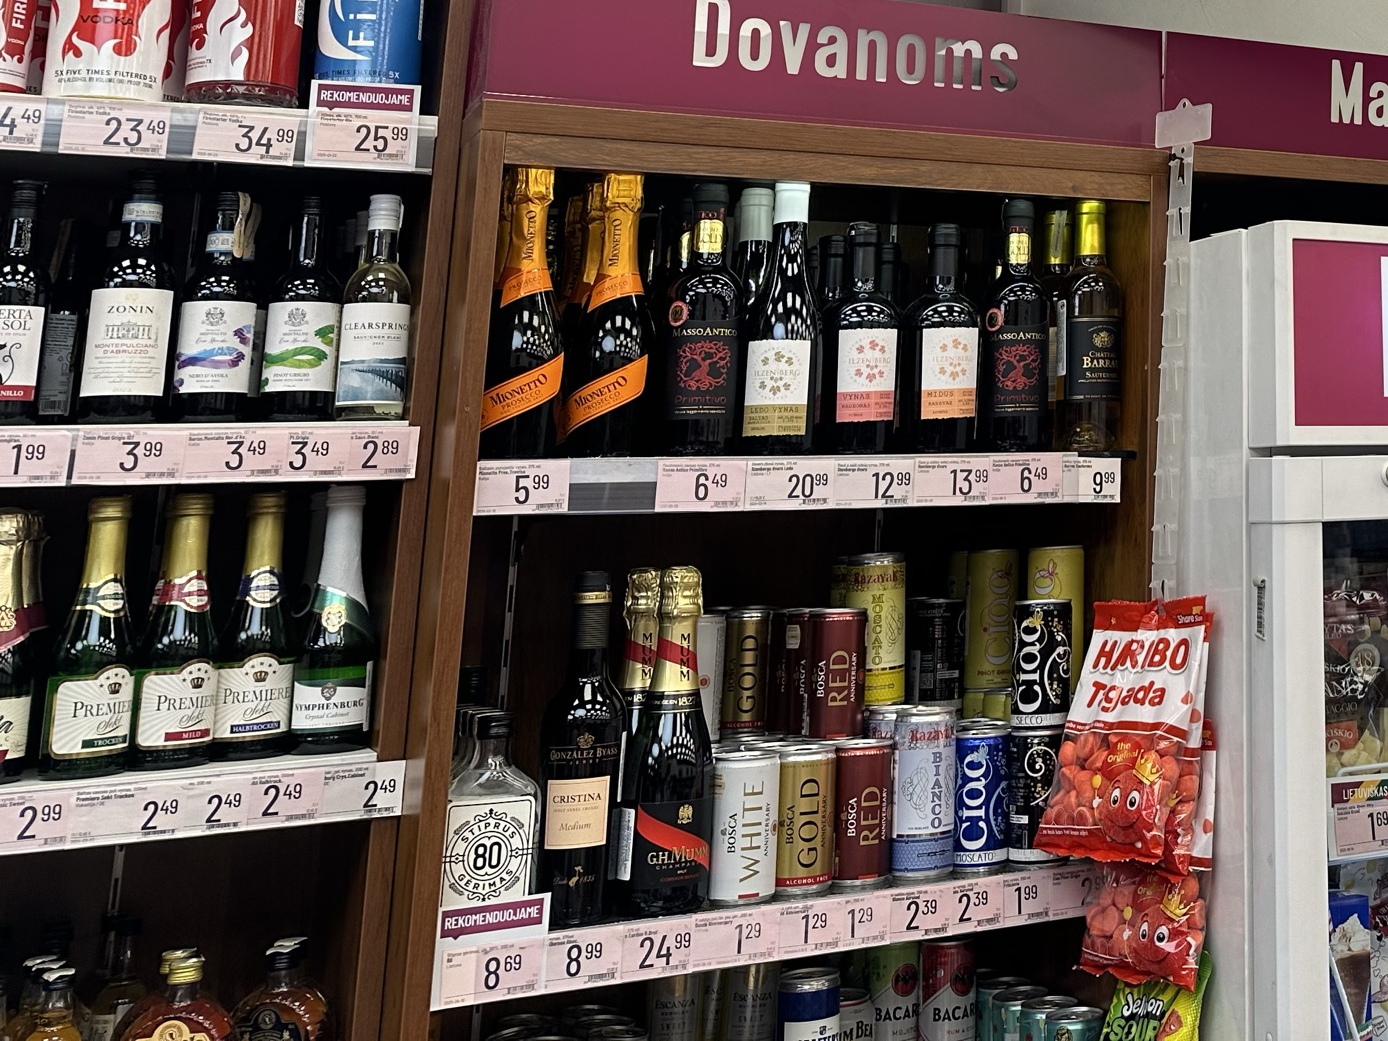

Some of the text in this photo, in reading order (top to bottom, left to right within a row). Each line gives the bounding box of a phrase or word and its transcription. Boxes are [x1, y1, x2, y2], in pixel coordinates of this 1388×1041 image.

[80, 14, 135, 27] VODKA
[66, 68, 82, 76] FIVE
[114, 70, 148, 80] FILTERED
[149, 75, 158, 83] 5X
[320, 90, 411, 106] REKOMENDUOJAME
[102, 116, 166, 147] 23 49
[234, 124, 294, 155] 34 99
[355, 124, 409, 153] 25 99
[523, 209, 538, 263] MIONETTO
[607, 218, 623, 268] MIONETTO
[107, 305, 155, 314] ZONIN
[10, 319, 31, 331] SOL
[94, 342, 159, 350] MONTEPULCIANO
[489, 373, 549, 409] MIONETTO
[573, 374, 628, 410] MIONETTO
[675, 394, 727, 405] Primitivo
[772, 405, 799, 413] VYNAS
[361, 440, 400, 469] 2 89
[514, 473, 550, 505] 5 99
[787, 473, 829, 498] 20 99
[871, 593, 885, 666] MOSCATO
[680, 632, 691, 682] MUMM
[736, 634, 759, 714] GOLD
[816, 660, 827, 698] BOSCA
[827, 650, 849, 707] RED
[222, 686, 290, 704] PREMIERE
[294, 698, 365, 712] NYMPHENBURG
[1087, 680, 1167, 713] Tgada
[243, 702, 272, 721] Sekt
[1015, 716, 1043, 725] SECCO
[93, 737, 123, 747] TROCKEN
[181, 731, 202, 739] MILD
[232, 721, 280, 734] HALBTROCKEN
[596, 746, 618, 758] BYASS
[1117, 742, 1131, 752] the
[261, 782, 302, 817] 2 49
[552, 792, 602, 805] CRISTINA
[931, 752, 943, 830] BIANCO
[1342, 784, 1388, 800] LIETUVIŠKAS
[16, 803, 62, 840] 2 99
[558, 821, 592, 832] Medium
[785, 804, 796, 845] BOSCA
[797, 777, 820, 868] GOLD
[860, 786, 881, 847] RED
[460, 822, 518, 844] STIPRUS
[726, 813, 738, 854] BOSCA
[738, 780, 764, 884] WHITE
[473, 841, 503, 871] 80
[955, 852, 995, 863] MOSCATO
[785, 877, 816, 885] ALCOHOL
[444, 905, 541, 931] REKOMENDUOJAME
[905, 899, 938, 931] 2 39
[639, 933, 672, 970] 24
[674, 932, 691, 949] 99
[484, 956, 500, 991] 8
[503, 954, 522, 972] 69
[1108, 1017, 1161, 1041] SOUR
